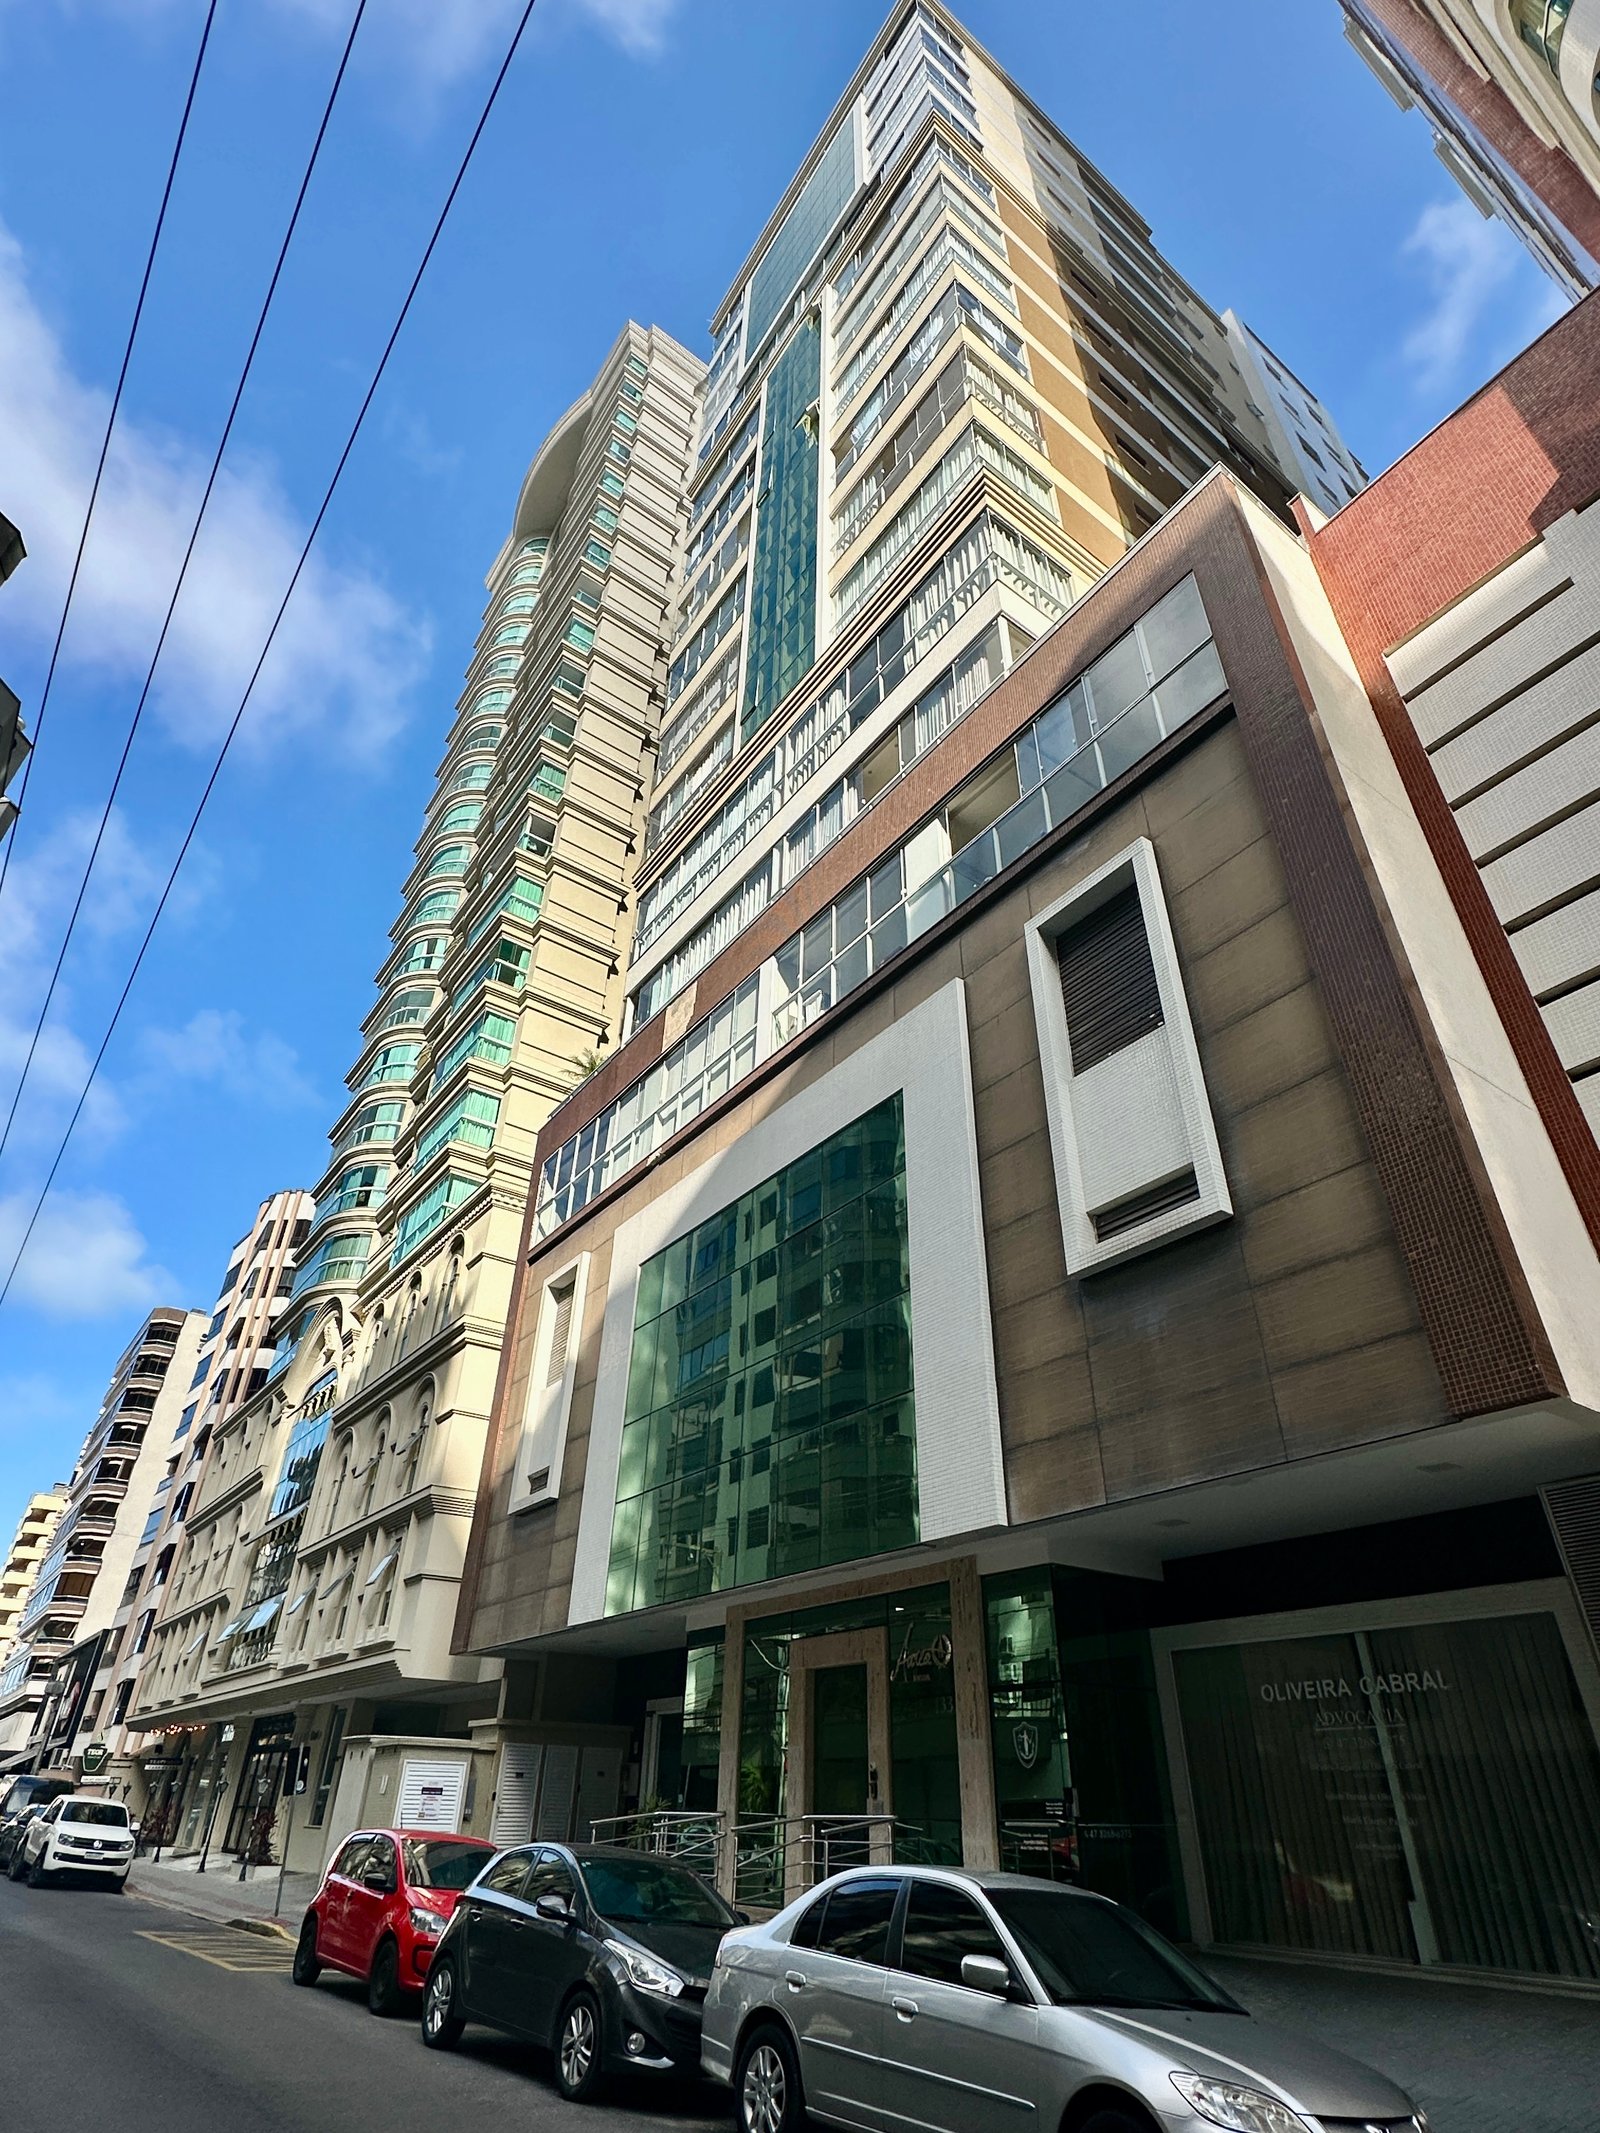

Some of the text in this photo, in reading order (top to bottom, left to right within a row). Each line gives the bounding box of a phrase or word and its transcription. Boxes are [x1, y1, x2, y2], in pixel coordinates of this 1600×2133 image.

[1260, 1670, 1449, 1702] OLIVEIRA CABRAL
[1315, 1708, 1405, 1726] ADVOCAIA
